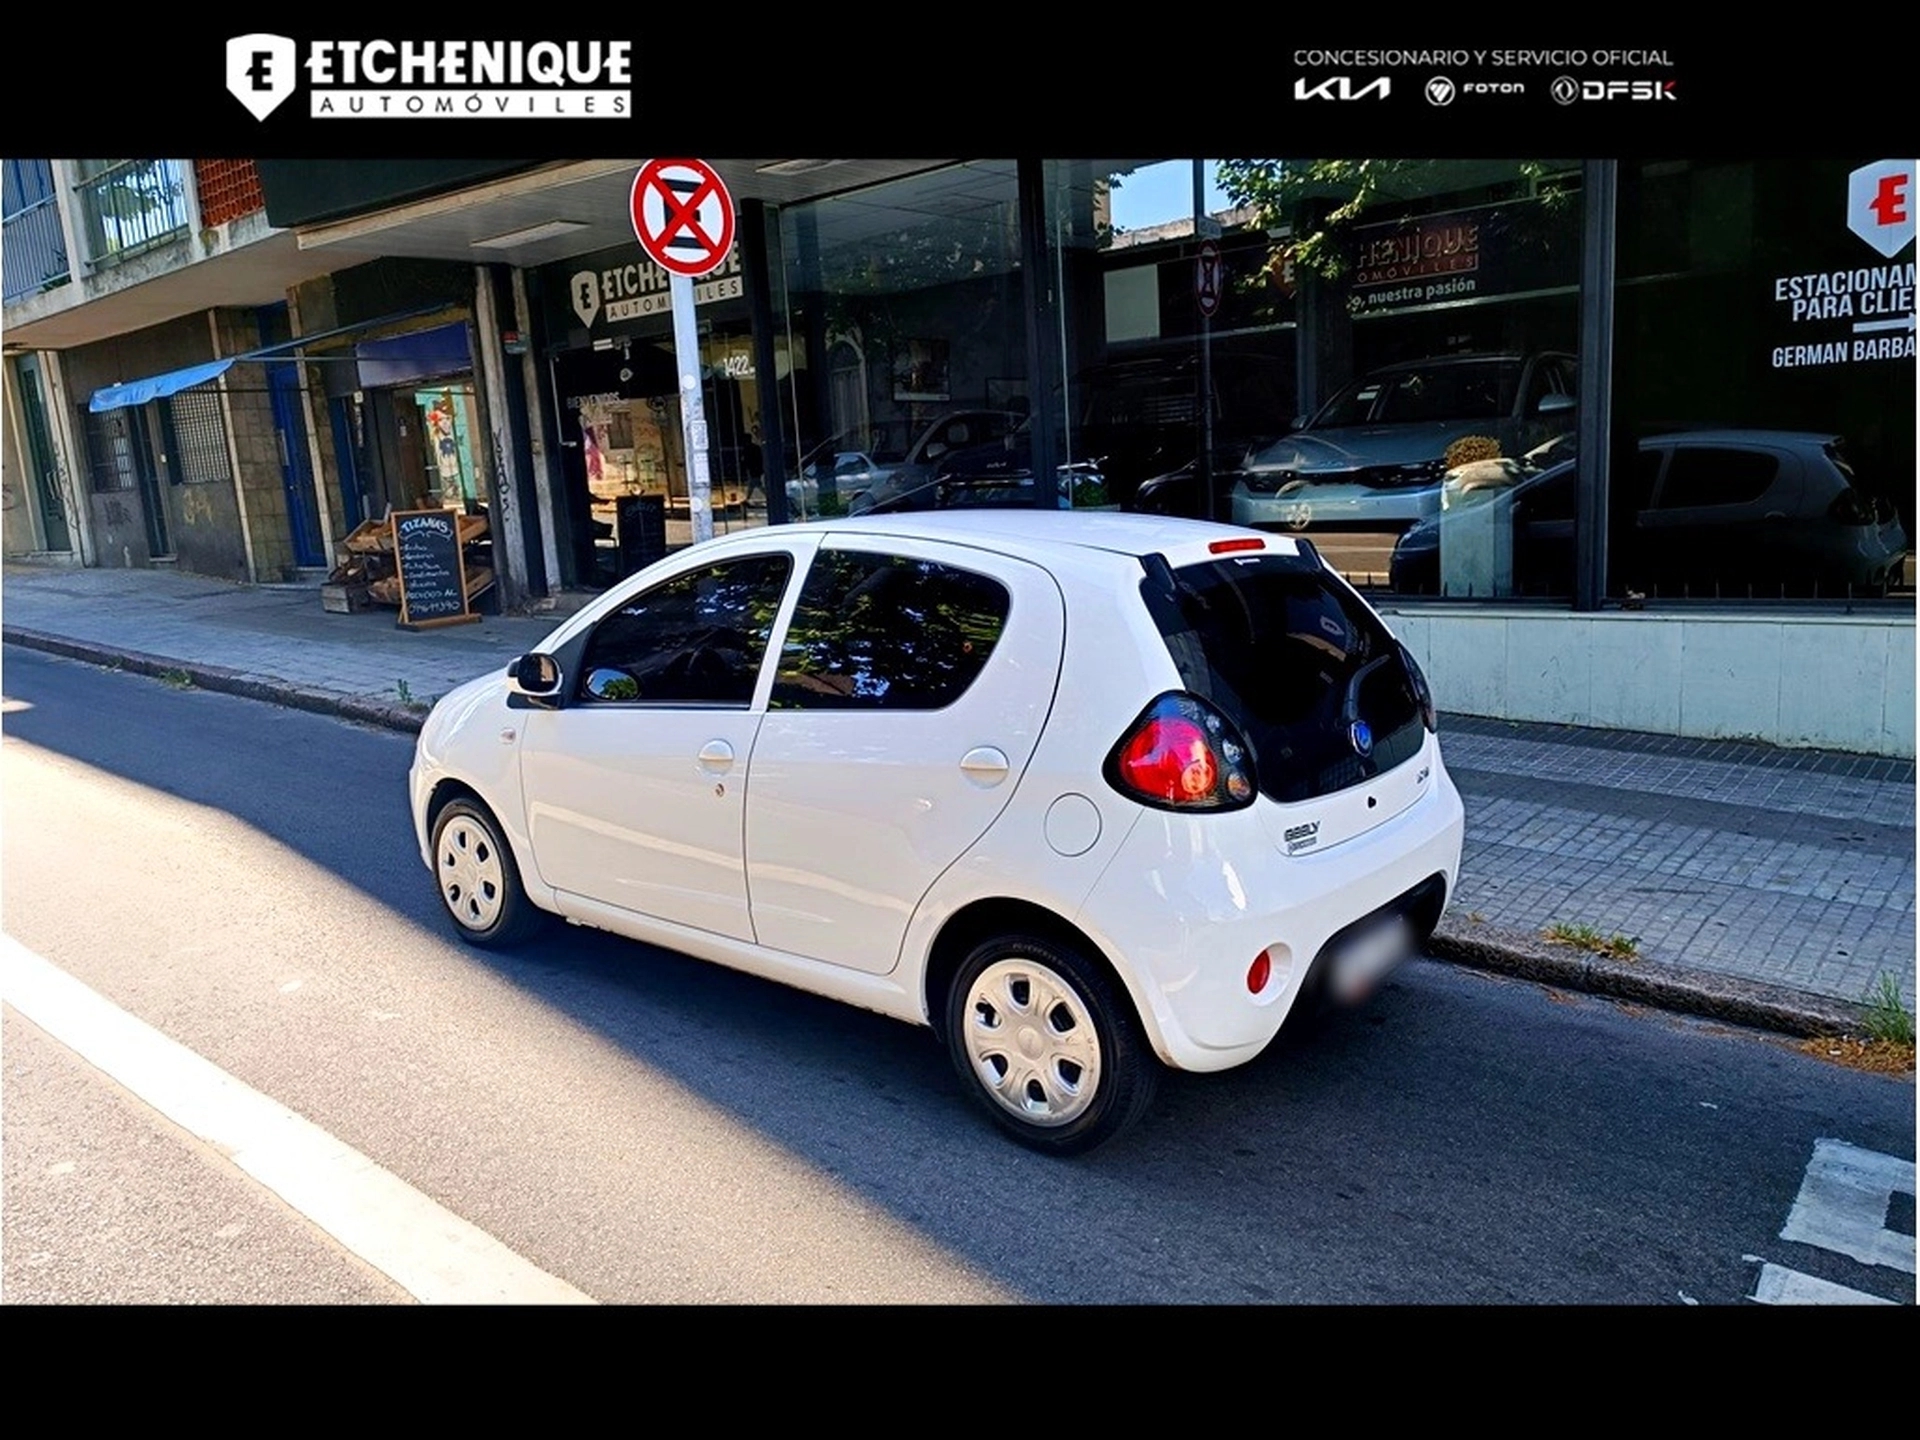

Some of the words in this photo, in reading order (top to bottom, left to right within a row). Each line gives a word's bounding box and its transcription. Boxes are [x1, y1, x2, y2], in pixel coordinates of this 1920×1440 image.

[1368, 285, 1423, 304] nuestra
[1425, 276, 1476, 300] pasión
[1792, 294, 1854, 322] PARA
[1860, 287, 1917, 315] CLIE
[1772, 341, 1848, 368] GERMAN
